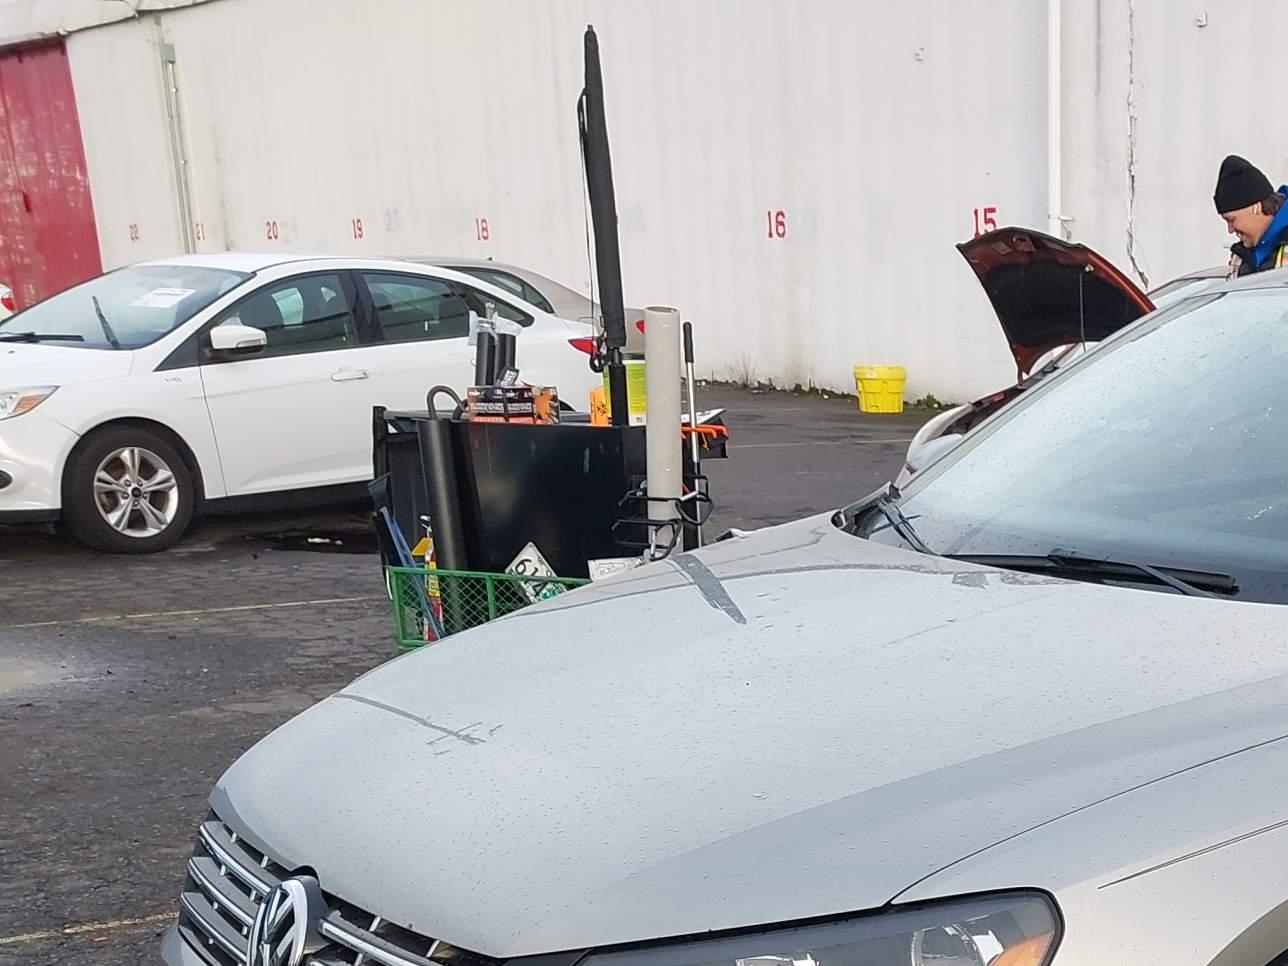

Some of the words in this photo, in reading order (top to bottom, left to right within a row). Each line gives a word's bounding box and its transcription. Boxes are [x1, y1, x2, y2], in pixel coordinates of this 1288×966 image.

[265, 221, 279, 240] 20
[352, 218, 363, 239] 19
[475, 218, 489, 240] 18
[768, 210, 786, 238] 16
[974, 207, 997, 240] 15
